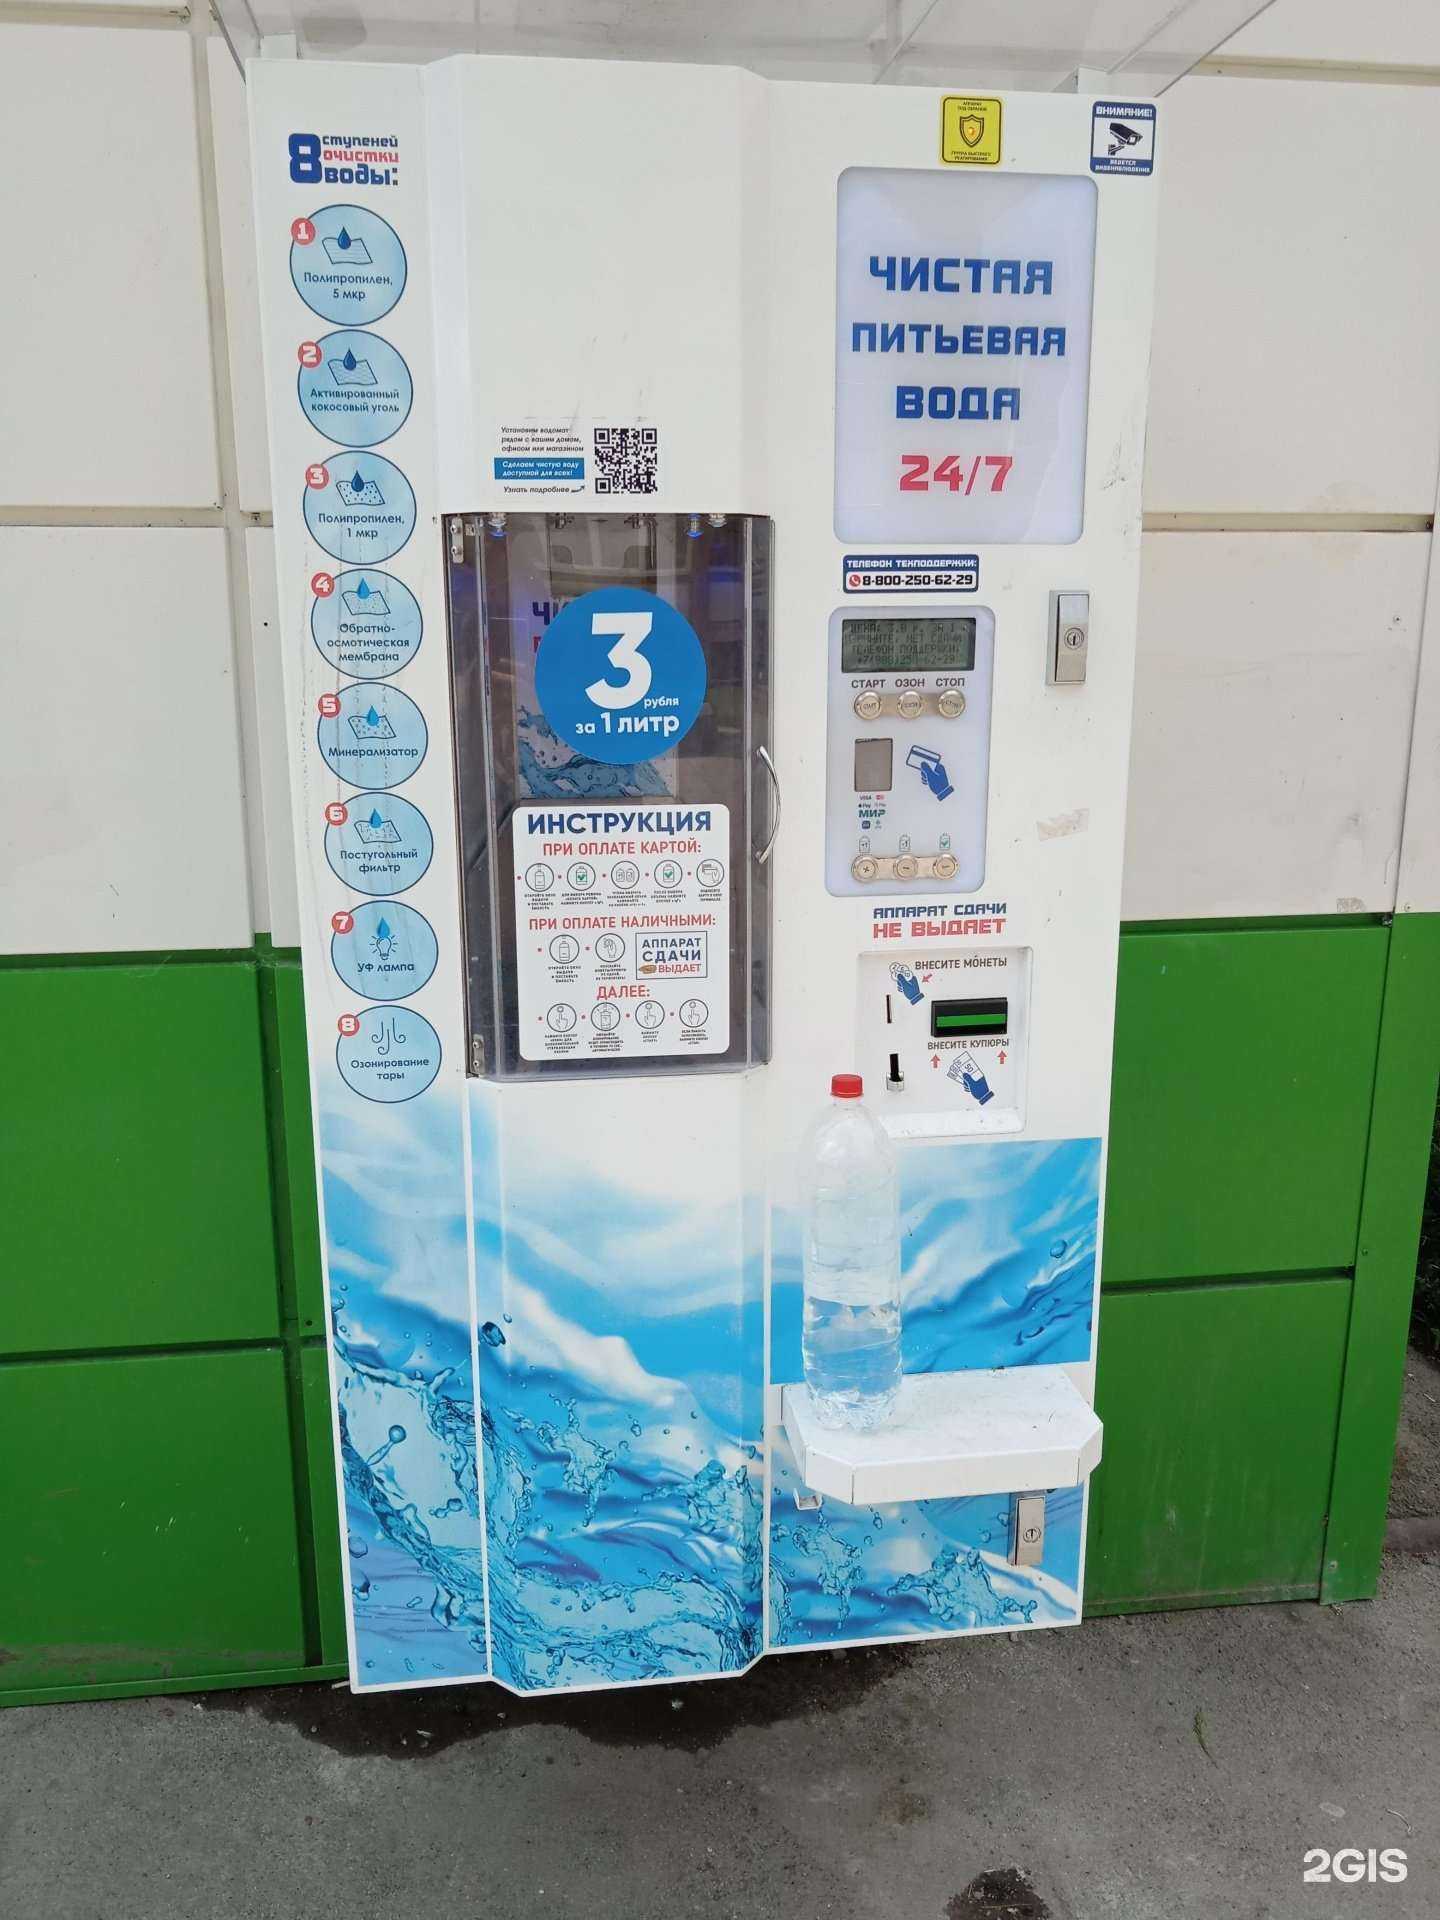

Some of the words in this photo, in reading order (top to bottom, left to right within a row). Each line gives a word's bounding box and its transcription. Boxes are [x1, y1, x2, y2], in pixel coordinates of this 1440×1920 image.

[1095, 106, 1153, 117] ВНИМАНИЕ!
[322, 135, 398, 149] ступеней
[288, 133, 323, 184] 8
[323, 150, 399, 163] очистки
[324, 163, 398, 186] воды:
[297, 222, 309, 240] 1
[303, 271, 393, 286] Полипропилен,
[869, 255, 1053, 295] ЧИСТАЯ
[333, 288, 340, 299] 5
[342, 290, 366, 301] мкр
[852, 322, 1066, 356] ПИТЬЕВАЯ
[302, 345, 317, 363] 2
[310, 387, 400, 400] Активированный
[311, 402, 369, 412] кокосовый
[371, 404, 400, 414] уголь
[896, 385, 1020, 420] ВОДА
[310, 467, 324, 484] 3
[899, 454, 1013, 496] 24/7
[503, 486, 528, 494] Узнать
[529, 486, 570, 495] подробнее
[318, 513, 405, 525] Полипропилен,
[347, 527, 352, 538] 1
[355, 529, 378, 540] мкр
[846, 560, 893, 568] ТЕЛЕФОН
[895, 559, 977, 568] ТЕХПОДДЕРЖКИ:
[315, 576, 330, 592] 4
[862, 574, 973, 586] 8-800-250-62-29
[339, 623, 396, 634] Обратно-
[327, 639, 410, 648] осмотическая
[338, 652, 399, 663] мембрана
[584, 611, 653, 710] 3
[851, 679, 886, 689] СТАРТ
[895, 678, 925, 688] ОЗОН
[935, 677, 965, 687] СТОП
[322, 696, 337, 713] 5
[643, 696, 680, 709] рубля
[575, 722, 596, 734] за
[600, 712, 611, 733] 1
[617, 714, 680, 737] литр
[328, 747, 418, 758] Минерализатор
[329, 805, 344, 822] 6
[858, 809, 886, 818] МИР
[527, 810, 711, 836] ИНСТРУКЦИЯ
[543, 842, 573, 856] ПРИ
[578, 841, 635, 855] ОПЛАТЕ
[640, 837, 702, 854] КАРТОЙ:
[340, 848, 418, 861] Постугольный
[359, 863, 401, 875] фильтр
[873, 905, 948, 919] АППАРАТ
[953, 902, 1007, 916] СДАЧИ
[335, 915, 349, 930] 7
[529, 918, 558, 930] ПРИ
[562, 916, 616, 929] ОПЛАТЕ
[621, 914, 716, 928] НАЛИЧНЫМИ:
[873, 922, 902, 938] НЕ
[911, 918, 1007, 937] ВЫДАЕТ
[642, 937, 701, 949] АППАРАТ
[642, 949, 701, 963] СДАЧИ
[357, 963, 374, 972] УФ
[376, 963, 415, 972] лампа
[658, 963, 701, 974] ВЫДАЕТ
[915, 959, 960, 970] ВНЕСИТЕ
[964, 957, 1007, 968] МОНЕТЫ
[596, 985, 650, 1000] ДАЛЕЕ:
[341, 1017, 355, 1032] 8
[927, 1040, 967, 1050] ВНЕСИТЕ
[970, 1038, 1010, 1048] КУПЮРЫ
[350, 1058, 430, 1070] Озонирование
[376, 1072, 405, 1081] тары
